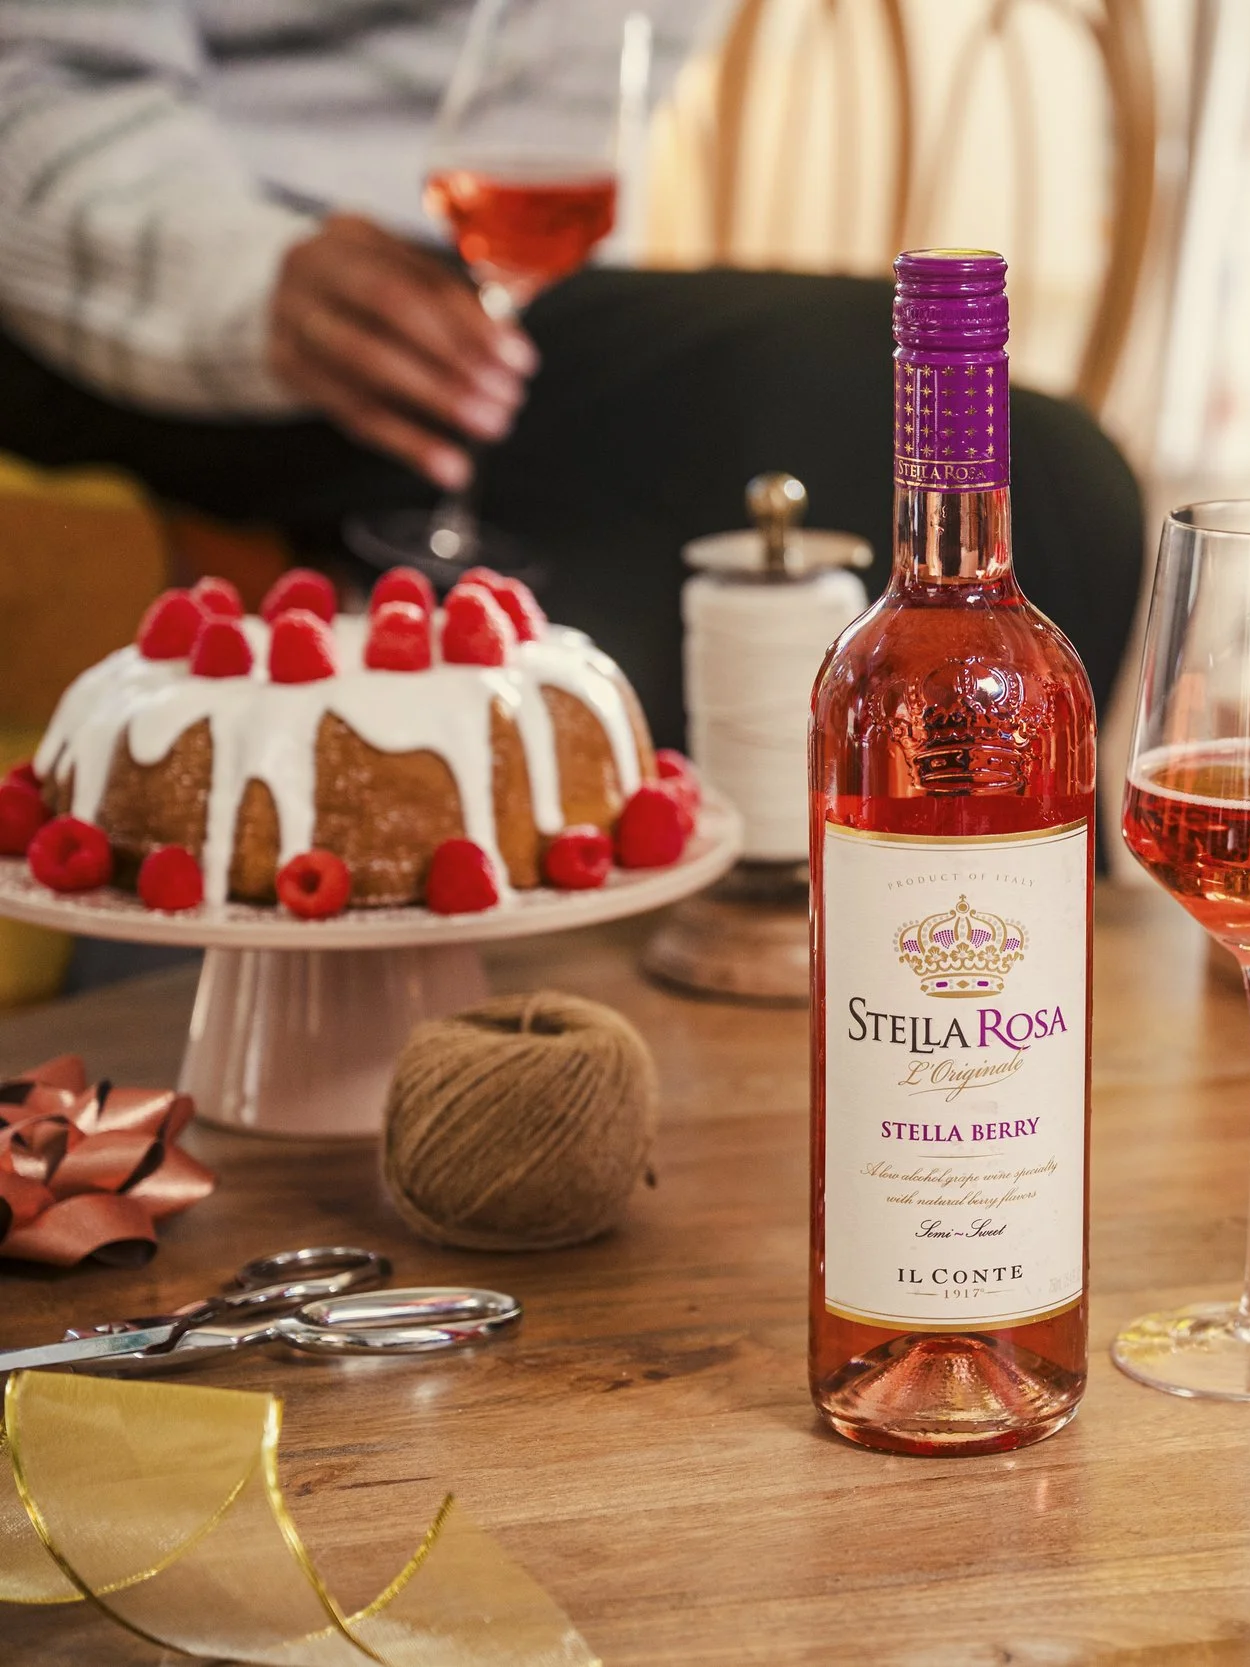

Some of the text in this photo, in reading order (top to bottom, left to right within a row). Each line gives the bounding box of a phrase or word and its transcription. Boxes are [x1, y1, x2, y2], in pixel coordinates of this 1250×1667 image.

[887, 873, 1036, 891] PRODUCT OF ITALY
[849, 997, 1068, 1054] STELLA ROSA
[898, 1046, 1024, 1102] L'Originale
[881, 1116, 1041, 1143] STELLA BERRY
[860, 1154, 1058, 1189] A low alcohol grape wine specially
[886, 1184, 1037, 1210] with natural berry flavors
[897, 1264, 1024, 1285] IL CONTE
